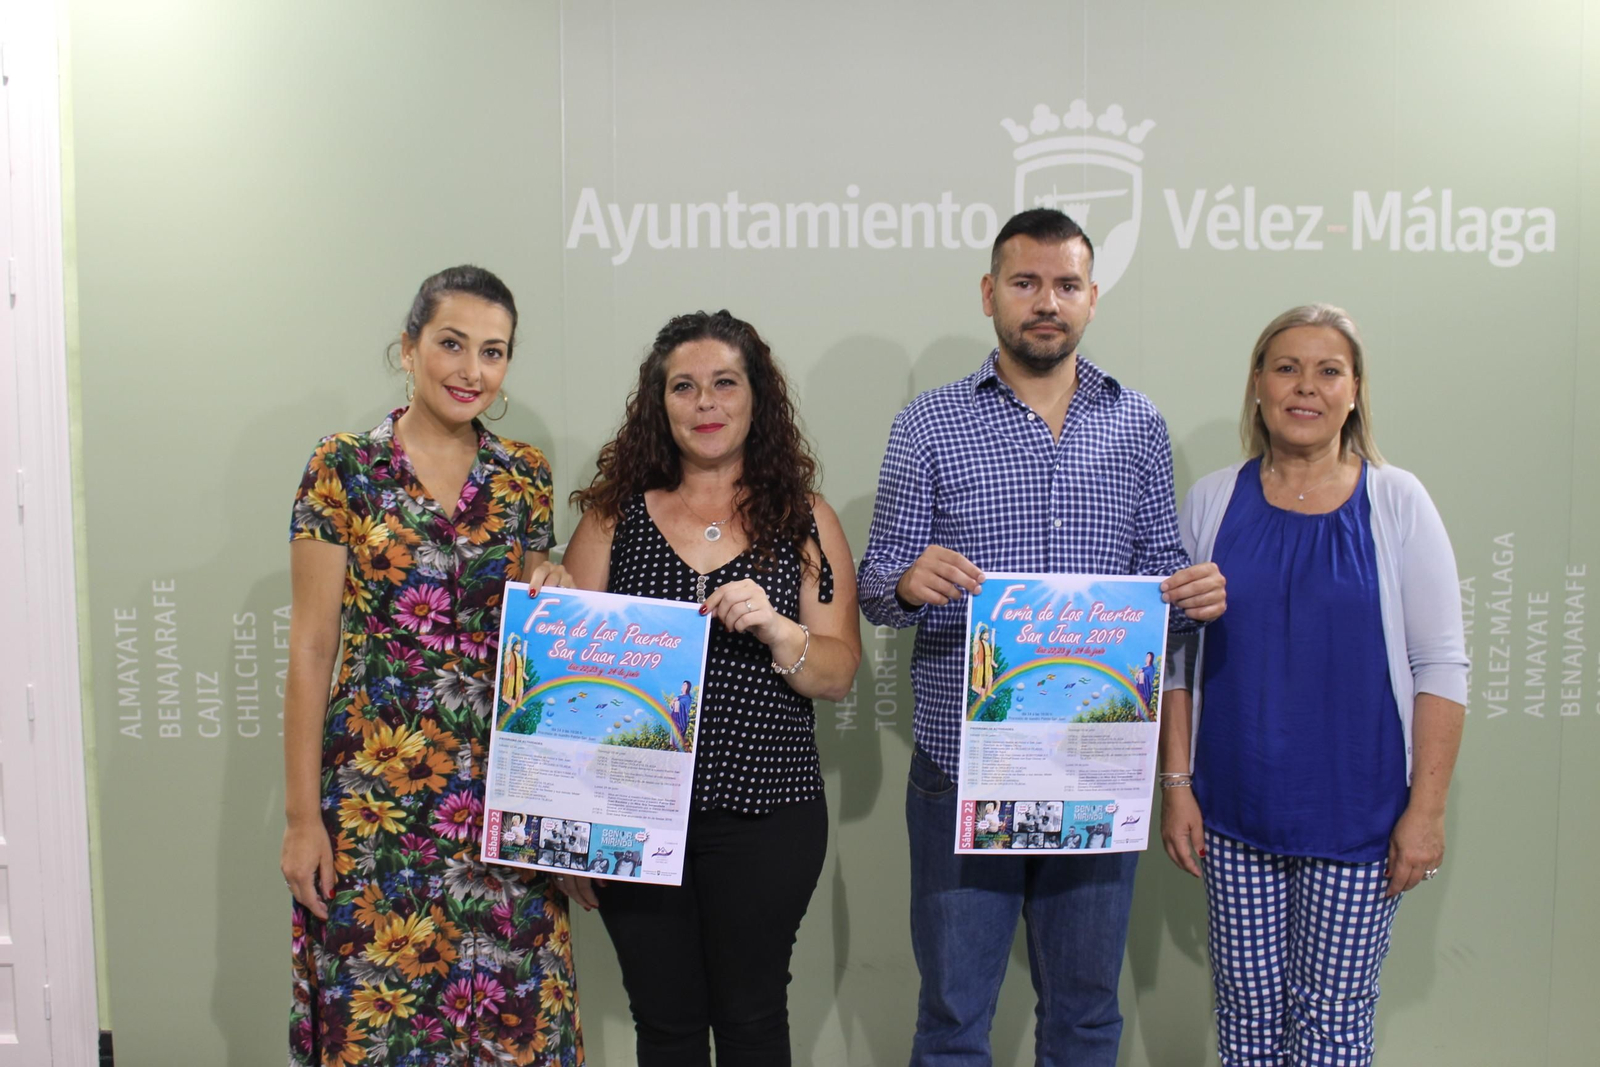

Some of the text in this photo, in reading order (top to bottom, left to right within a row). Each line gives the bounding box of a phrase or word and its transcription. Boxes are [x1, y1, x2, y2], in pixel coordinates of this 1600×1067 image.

[566, 183, 1556, 268] Ayuntamiento Vélez-Málaga
[523, 598, 566, 637] Feria
[569, 621, 588, 639] de
[623, 622, 682, 650] Puertas
[990, 584, 1033, 621] Feria
[1036, 603, 1054, 621] de
[1087, 601, 1144, 623] Puertas
[1016, 623, 1127, 645] San Juan 2019
[1482, 531, 1515, 719] VÉLEZ-MÁLAGA
[1560, 563, 1586, 717] BENAJARAFE
[114, 607, 142, 739] ALMAYATE
[152, 578, 182, 738] BENAJARAFE
[233, 611, 260, 738] CHILCHES
[548, 639, 662, 669] San Juan 2019
[874, 648, 897, 731] TORRE
[1524, 591, 1549, 718] ALMAYATE
[196, 671, 223, 738] CAJIZ
[487, 811, 500, 858] Sábado 22
[961, 802, 974, 848] Sábado 22
